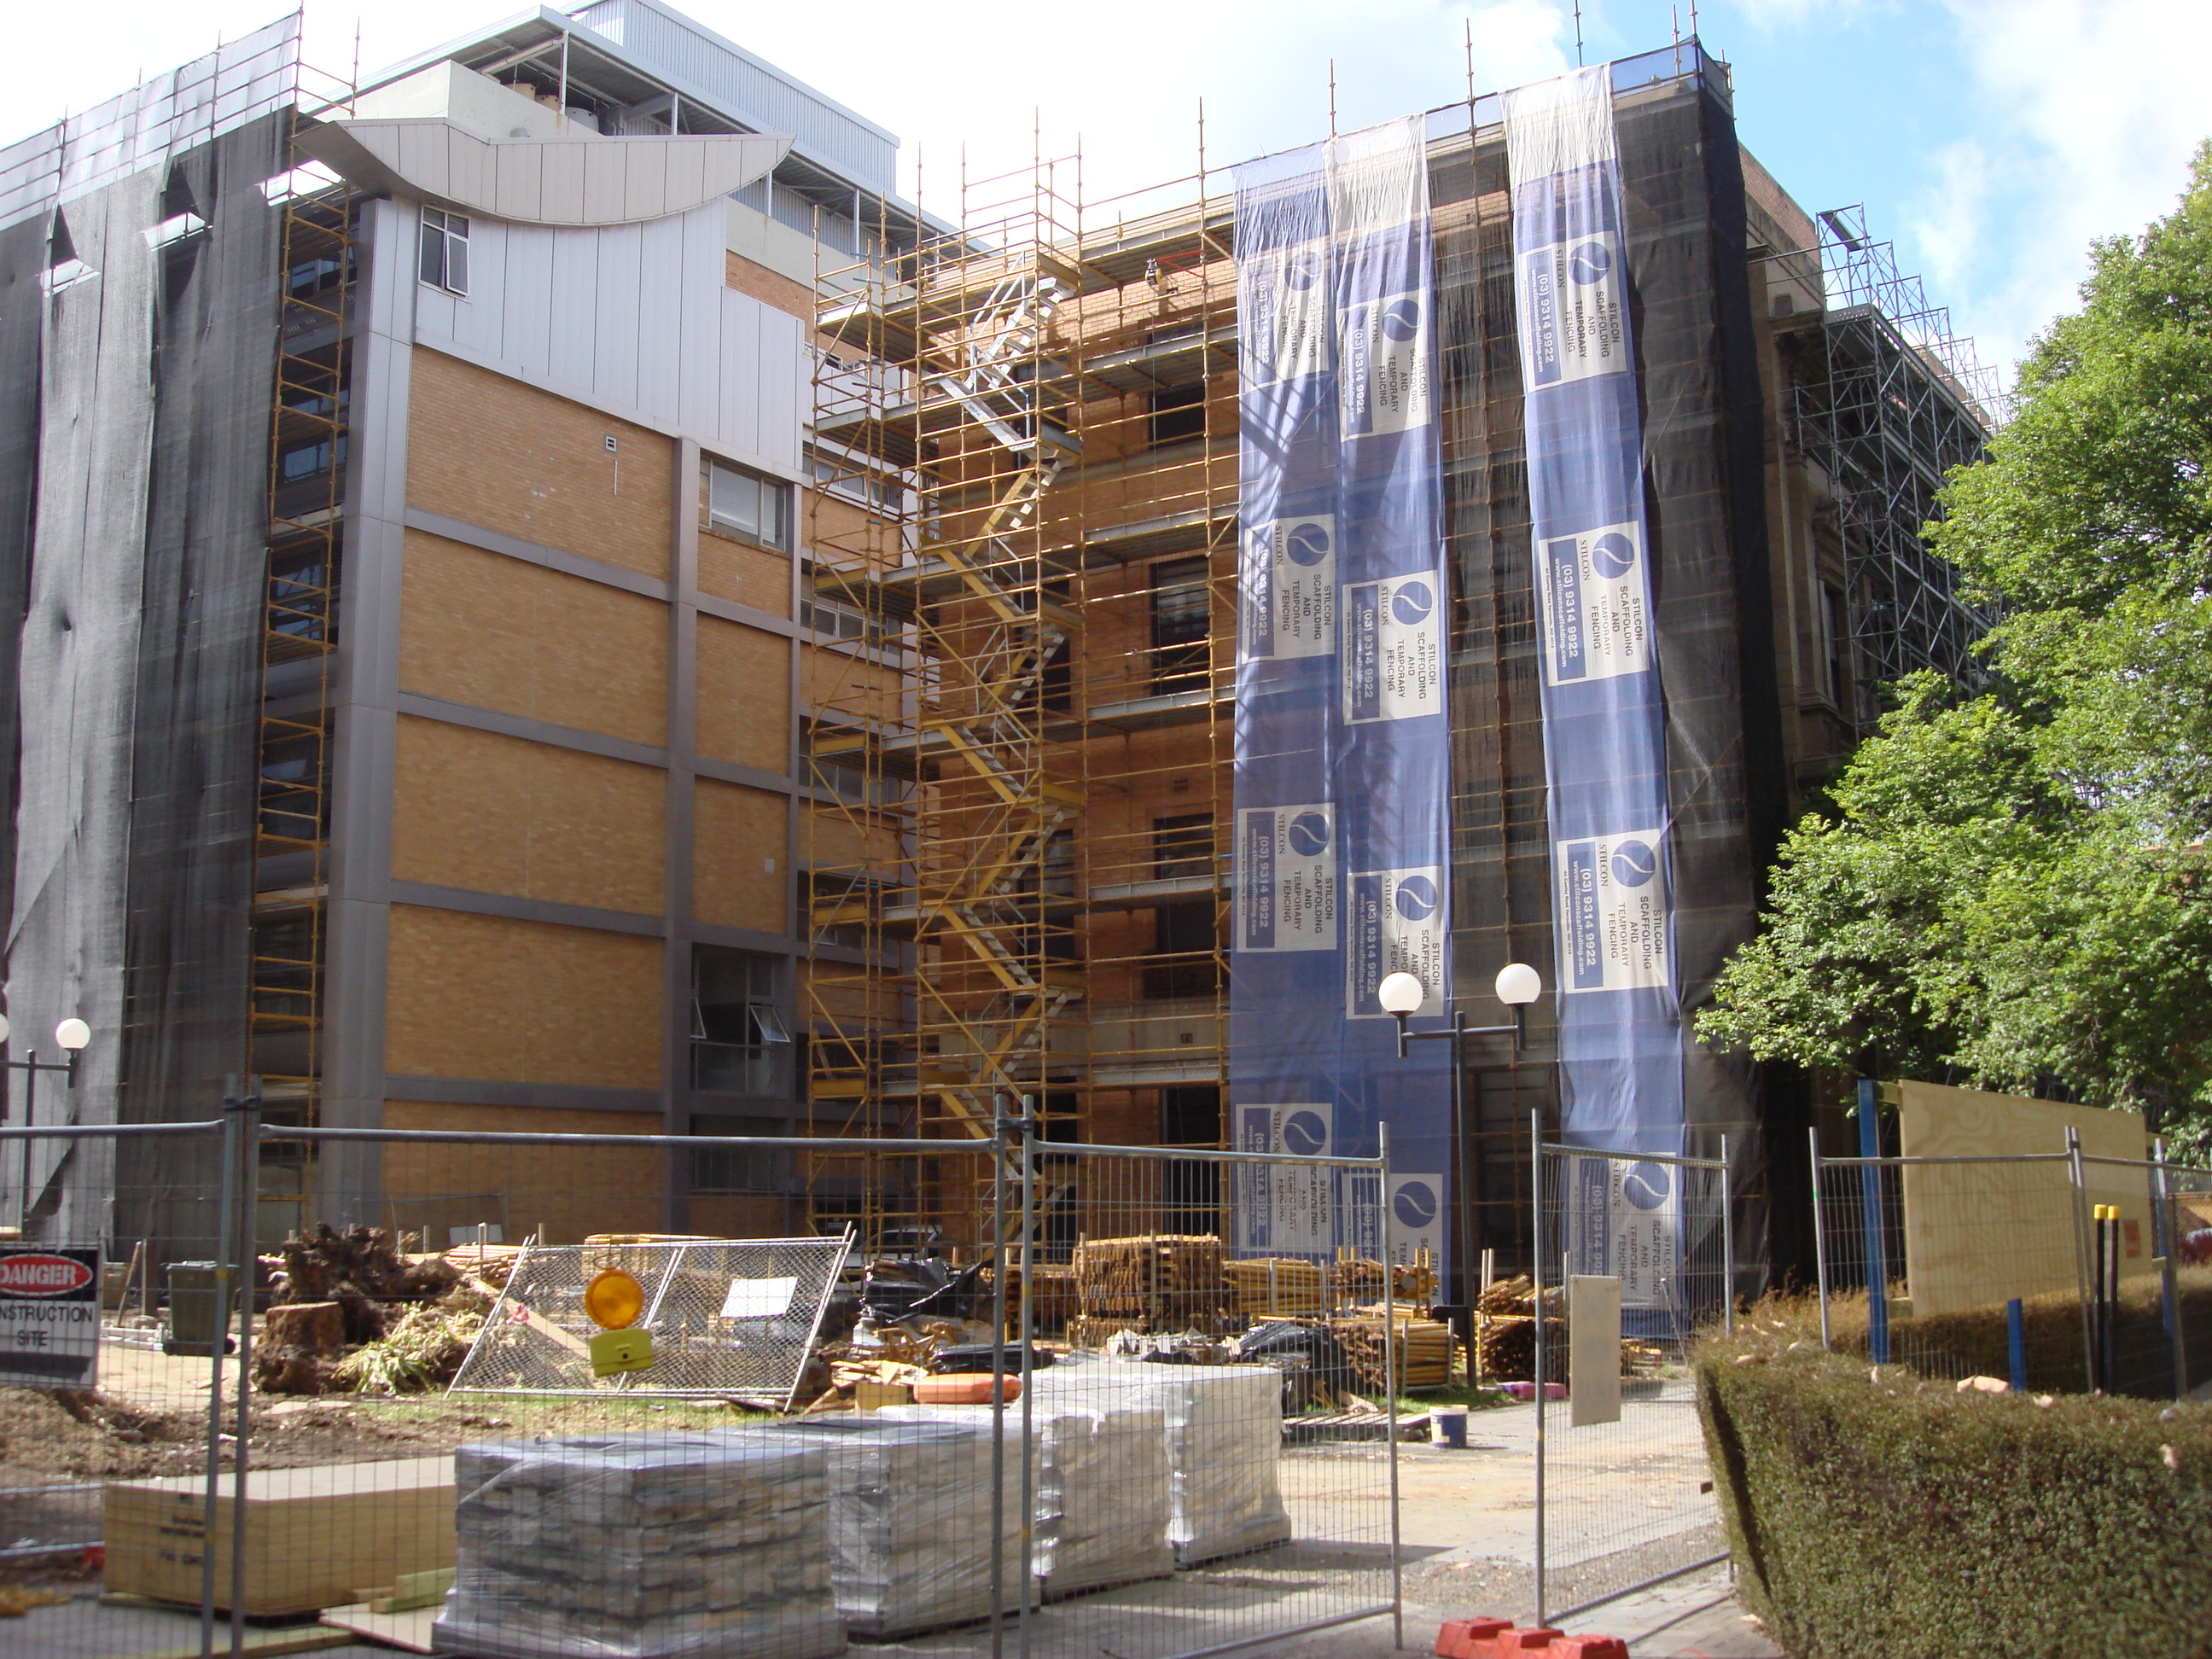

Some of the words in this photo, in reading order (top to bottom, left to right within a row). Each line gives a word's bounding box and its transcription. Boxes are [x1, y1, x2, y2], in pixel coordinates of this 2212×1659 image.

[1537, 273, 1549, 296] (03)
[1556, 249, 1565, 288] STILCON
[1260, 304, 1269, 334] 9314
[1541, 299, 1551, 329] 9314
[1575, 300, 1587, 358] TEMPORARY
[1587, 316, 1596, 335] AND
[1596, 291, 1610, 358] SCAFFOLDING
[1609, 302, 1620, 343] STILCON
[1289, 306, 1298, 359] TEMPORARY
[1353, 329, 1364, 350] (03)
[1565, 311, 1575, 352] FENCING
[1260, 337, 1270, 364] 9922
[1544, 332, 1554, 364] 9922
[1355, 352, 1364, 381] 9314
[1418, 358, 1427, 397] STILCON
[1356, 384, 1365, 414] 9922
[1378, 365, 1387, 406] FENCING
[1388, 355, 1399, 413] TEMPORARY
[1561, 564, 1573, 588] (03)
[1580, 540, 1590, 581] STILCON
[1259, 573, 1267, 604] 9314
[1259, 607, 1267, 637] 9922
[1363, 608, 1373, 632] (03)
[1565, 591, 1575, 623] 9314
[1620, 585, 1633, 656] SCAFFOLDING
[1632, 597, 1643, 641] STILCON
[1591, 606, 1601, 649] FENCING
[1600, 594, 1611, 655] TEMPORARY
[1365, 634, 1373, 665] 9314
[1568, 626, 1578, 658] 9922
[1397, 639, 1406, 698] TEMPORARY
[1417, 632, 1426, 700] SCAFFOLDING
[1365, 668, 1373, 698] 9922
[1259, 836, 1269, 859] (03)
[1260, 863, 1269, 894] 9314
[1580, 868, 1592, 892] (03)
[1599, 844, 1608, 887] STILCON
[1260, 897, 1269, 928] 9922
[1314, 864, 1323, 934] SCAFFOLDING
[1366, 900, 1377, 923] (03)
[1583, 897, 1593, 929] 9314
[1367, 927, 1377, 958] 9314
[1608, 913, 1619, 958] FENCING
[1618, 902, 1629, 967] TEMPORARY
[1630, 921, 1639, 943] AND
[1640, 896, 1652, 969] SCAFFOLDING
[1654, 909, 1662, 954] STILCON
[1586, 933, 1595, 966] 9922
[1367, 962, 1377, 993] 9922
[1254, 1132, 1264, 1153] (03
[0, 1264, 76, 1285] DANGER
[0, 1305, 93, 1322] NSTRUCTION
[17, 1330, 48, 1346] SITE
